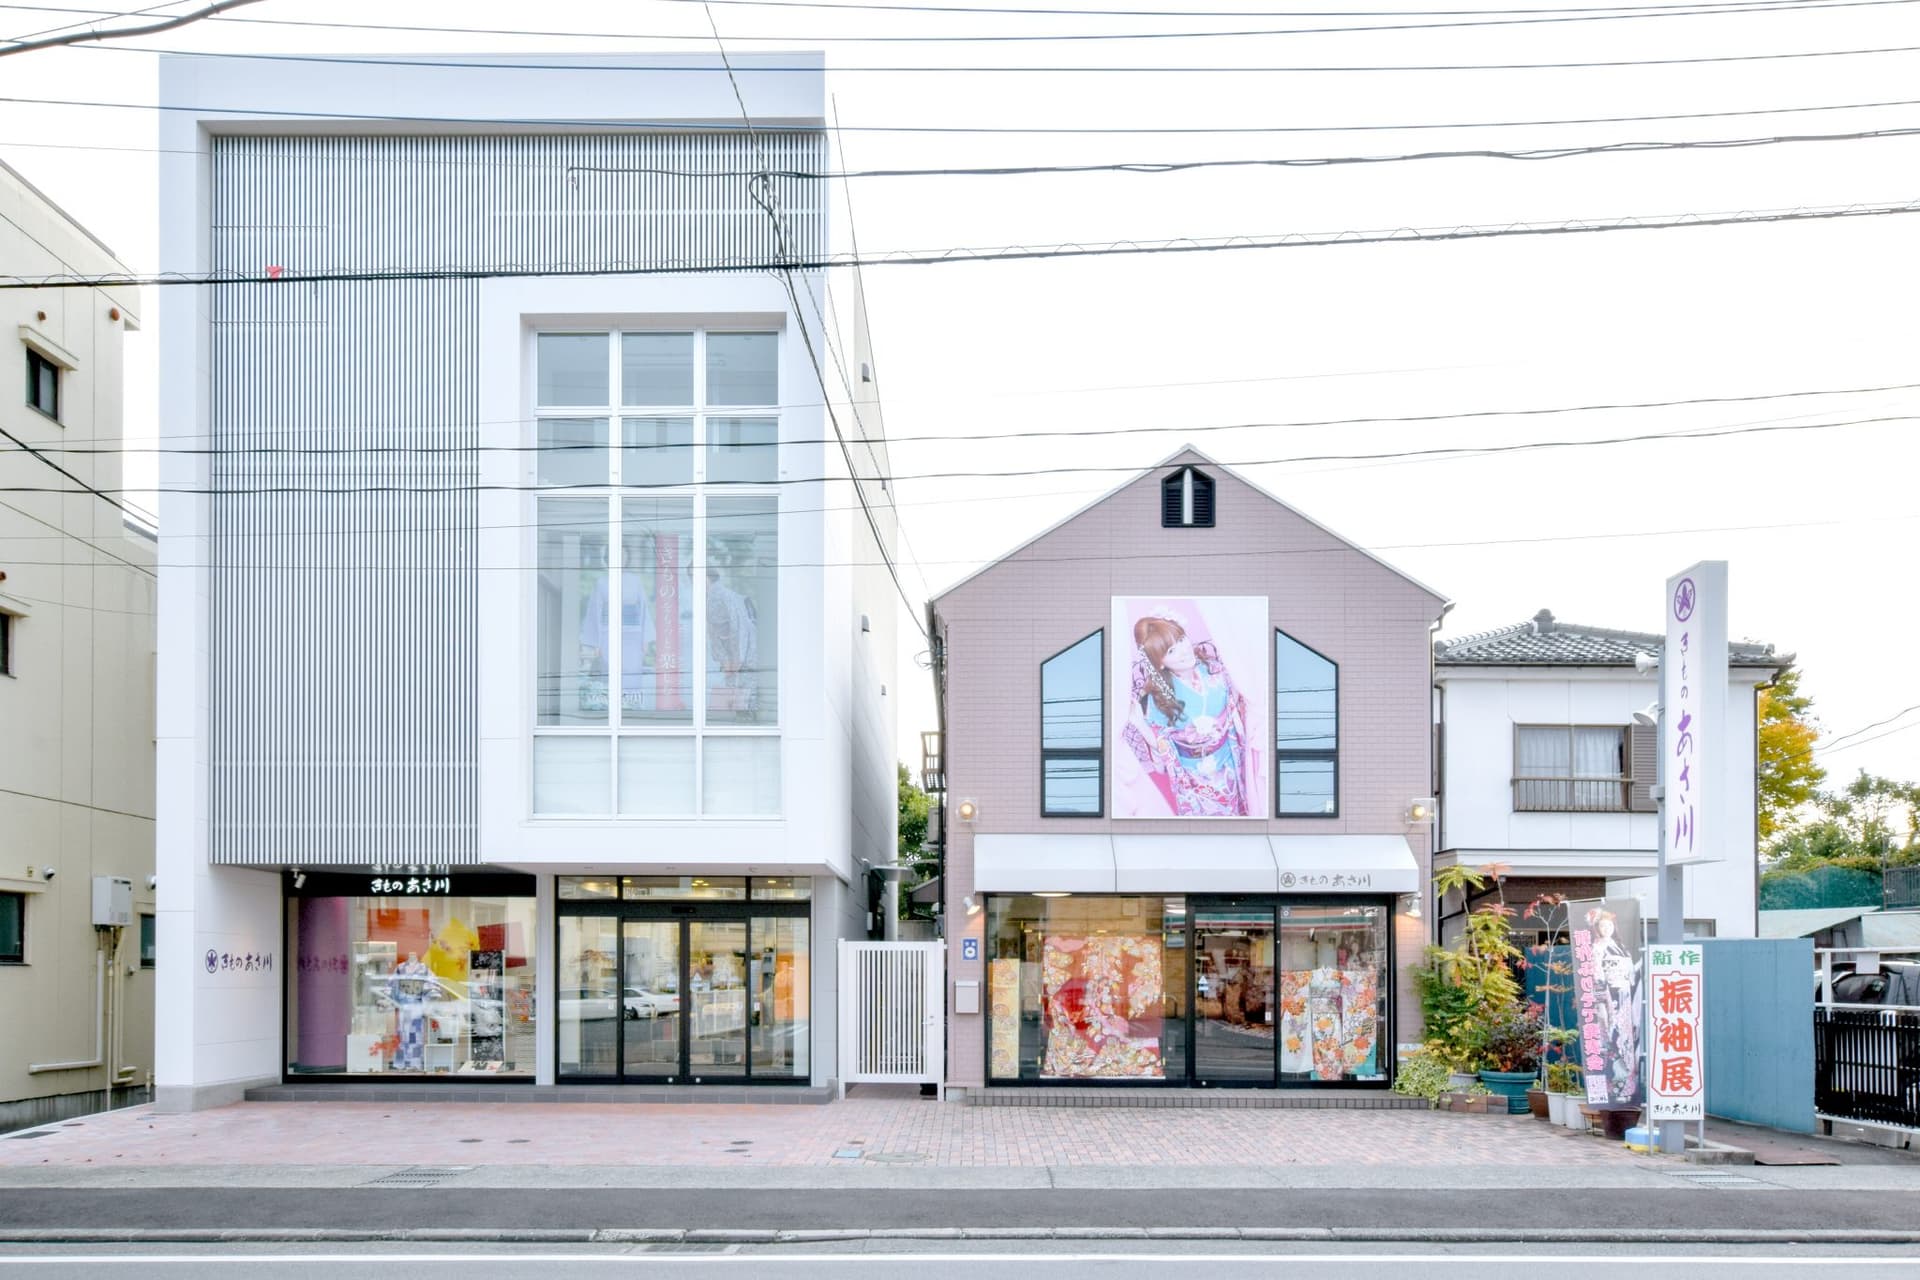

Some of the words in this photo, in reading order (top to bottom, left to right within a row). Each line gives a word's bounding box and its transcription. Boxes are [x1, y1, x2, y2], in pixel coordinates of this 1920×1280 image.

[1675, 631, 1693, 853] きものあさ川
[371, 877, 450, 894] きものあさ川
[1299, 873, 1371, 888] きものあさ川
[220, 952, 272, 972] きものあさ川
[1652, 950, 1700, 966] 新作
[1658, 978, 1693, 1091] 振袖展
[1653, 1102, 1701, 1115] きものあさ川
